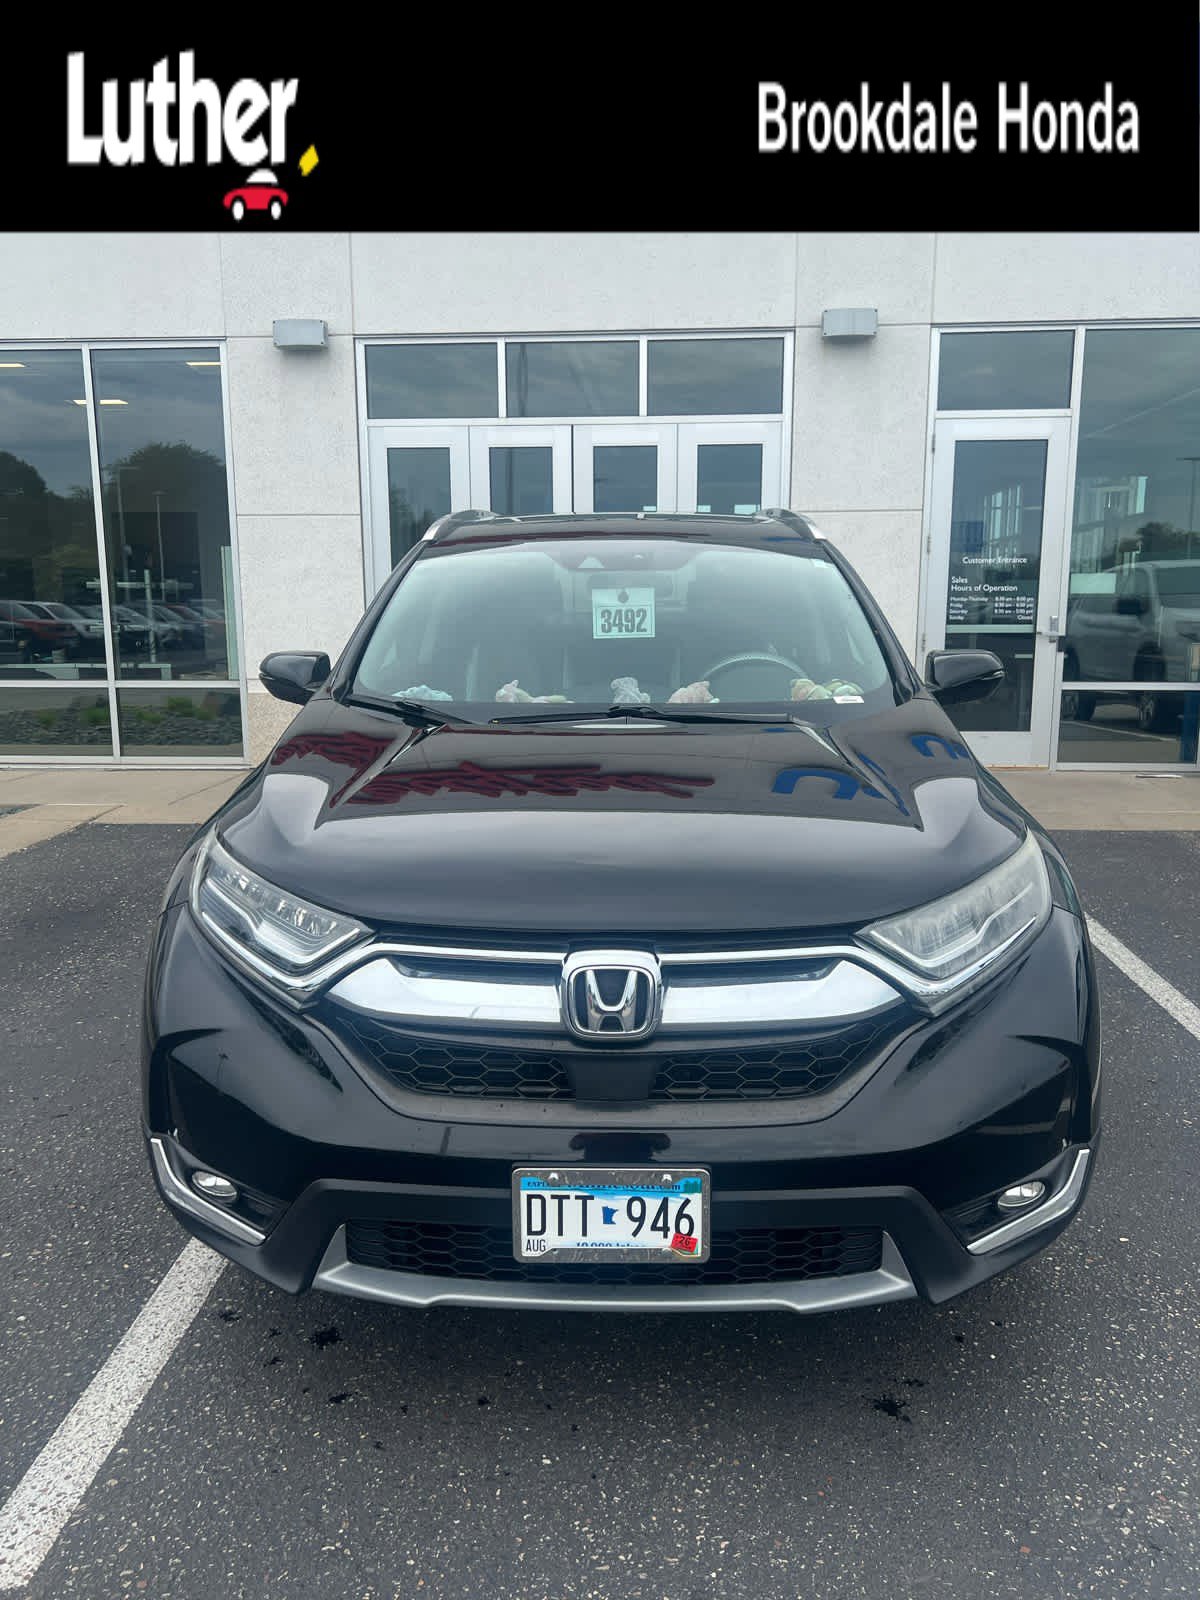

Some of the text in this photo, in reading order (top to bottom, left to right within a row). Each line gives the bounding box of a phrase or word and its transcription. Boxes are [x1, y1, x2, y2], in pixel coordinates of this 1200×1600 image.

[962, 556, 1028, 564] Customer Entrance
[951, 576, 968, 584] Sales
[951, 584, 1018, 593] Hours of Operation
[600, 607, 648, 634] 3492
[526, 1194, 695, 1239] DTT 946
[526, 1239, 546, 1253] AUG
